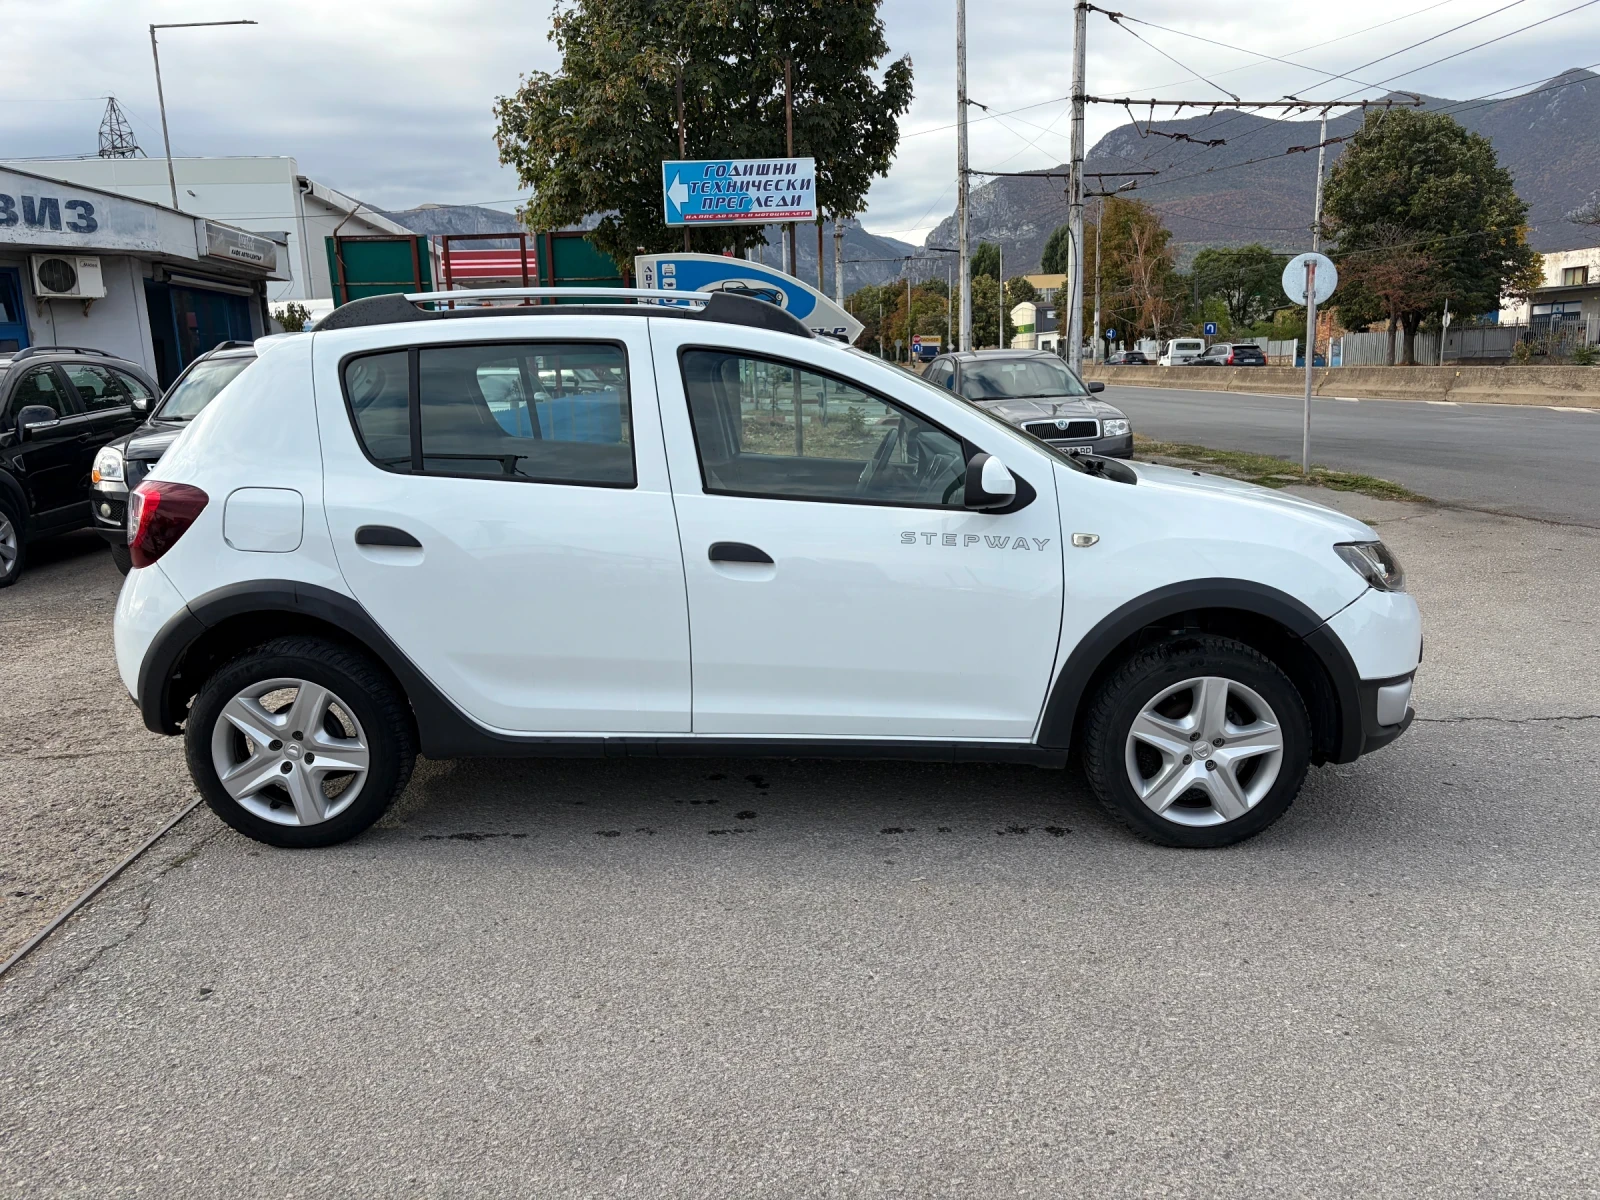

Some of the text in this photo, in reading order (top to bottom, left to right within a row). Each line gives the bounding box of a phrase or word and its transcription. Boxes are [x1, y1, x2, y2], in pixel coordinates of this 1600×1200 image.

[703, 163, 797, 178] ГОДИШНИ
[690, 178, 812, 195] ТЕХНИЧЕСКИ
[701, 194, 802, 211] ПРЕГЛЕДИ
[900, 531, 1051, 551] STEPWAY
